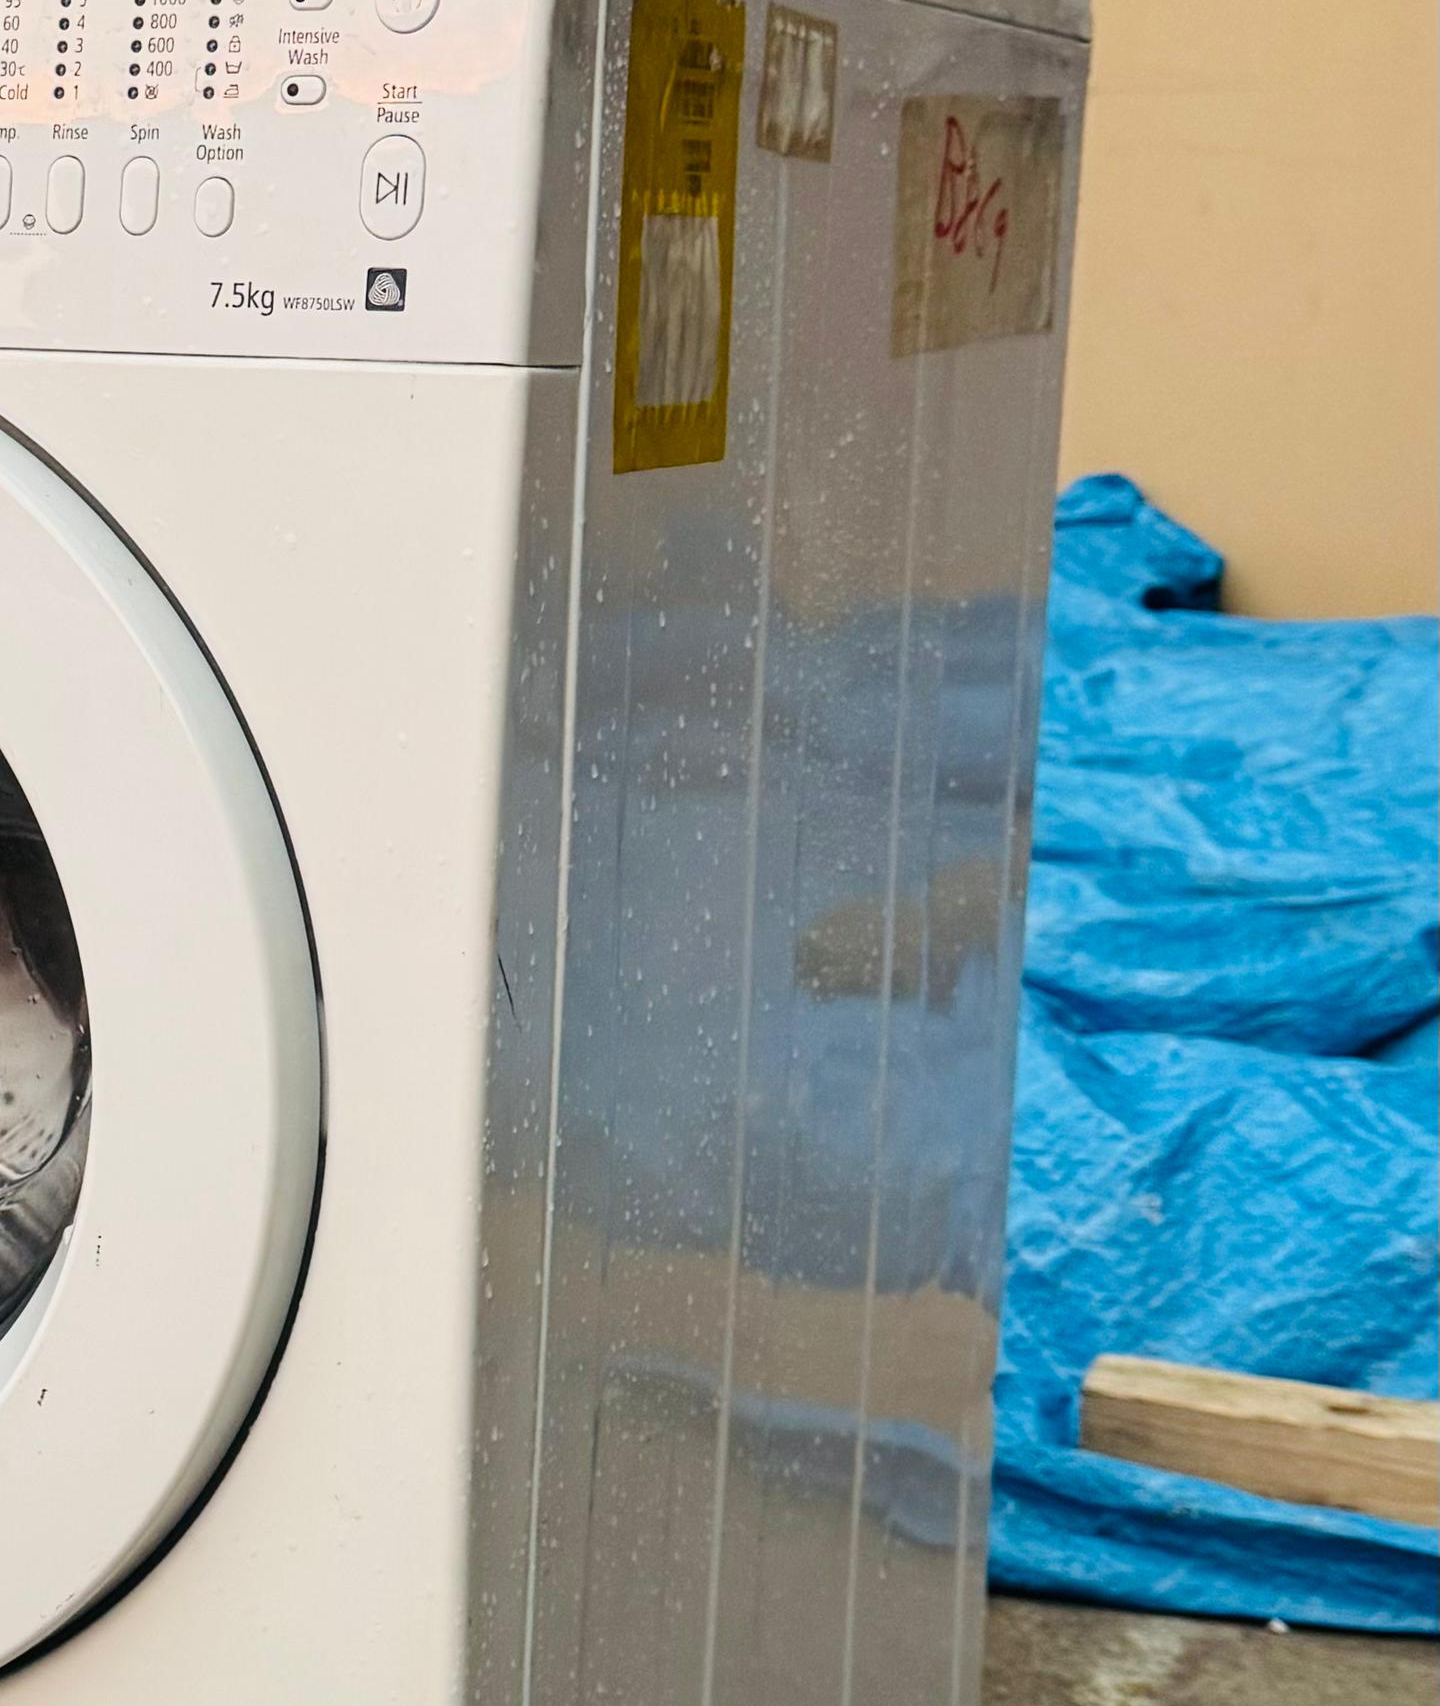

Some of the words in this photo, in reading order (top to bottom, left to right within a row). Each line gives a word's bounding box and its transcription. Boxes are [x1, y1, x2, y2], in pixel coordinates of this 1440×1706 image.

[3, 15, 20, 31] 60
[77, 14, 85, 30] 4
[150, 13, 177, 30] 800
[278, 27, 340, 45] Intensive
[1, 38, 19, 54] 40
[74, 38, 84, 53] 3
[147, 37, 175, 53] 600
[288, 48, 329, 65] Wash
[74, 61, 82, 77] 2
[146, 61, 173, 77] 400
[382, 82, 418, 100] Start
[376, 107, 420, 124] Pause
[52, 124, 89, 140] Rinse
[130, 124, 160, 144] Spin
[202, 123, 241, 141] Wash
[196, 144, 244, 164] Option
[210, 281, 275, 316] 7.5kg
[283, 296, 355, 311] WF8750LSW
